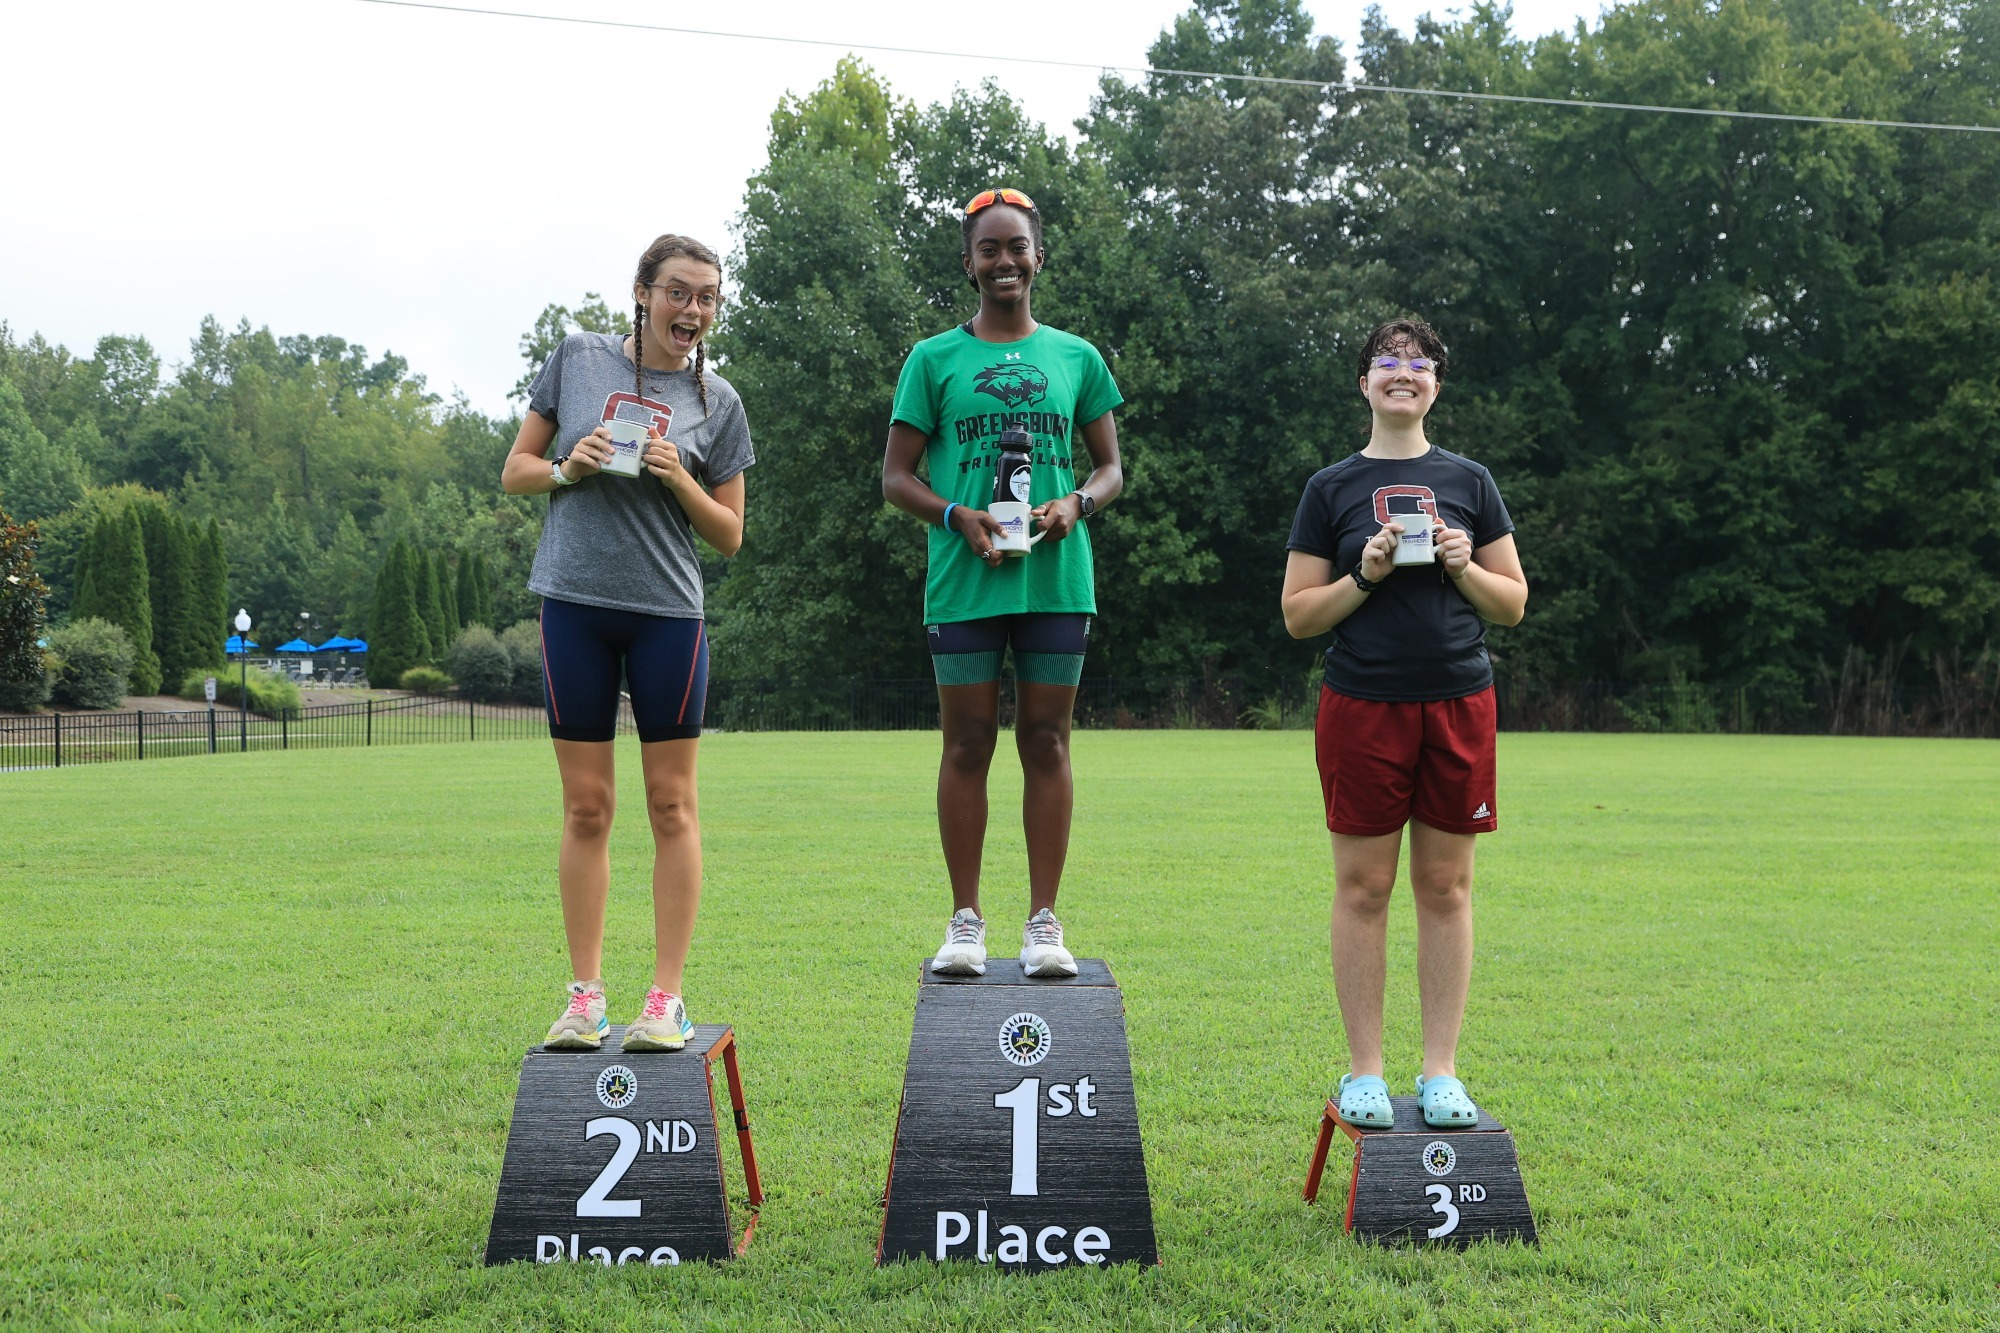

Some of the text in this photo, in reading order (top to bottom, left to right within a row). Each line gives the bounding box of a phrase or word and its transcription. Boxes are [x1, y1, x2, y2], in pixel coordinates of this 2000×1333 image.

[600, 391, 675, 439] G
[959, 453, 1070, 474] TRILON
[981, 439, 1053, 451] COGE
[1372, 484, 1439, 526] G
[993, 1075, 1098, 1196] 1st
[576, 1116, 698, 1218] 2ND
[1424, 1182, 1487, 1239] 3RD
[936, 1209, 1111, 1264] Place
